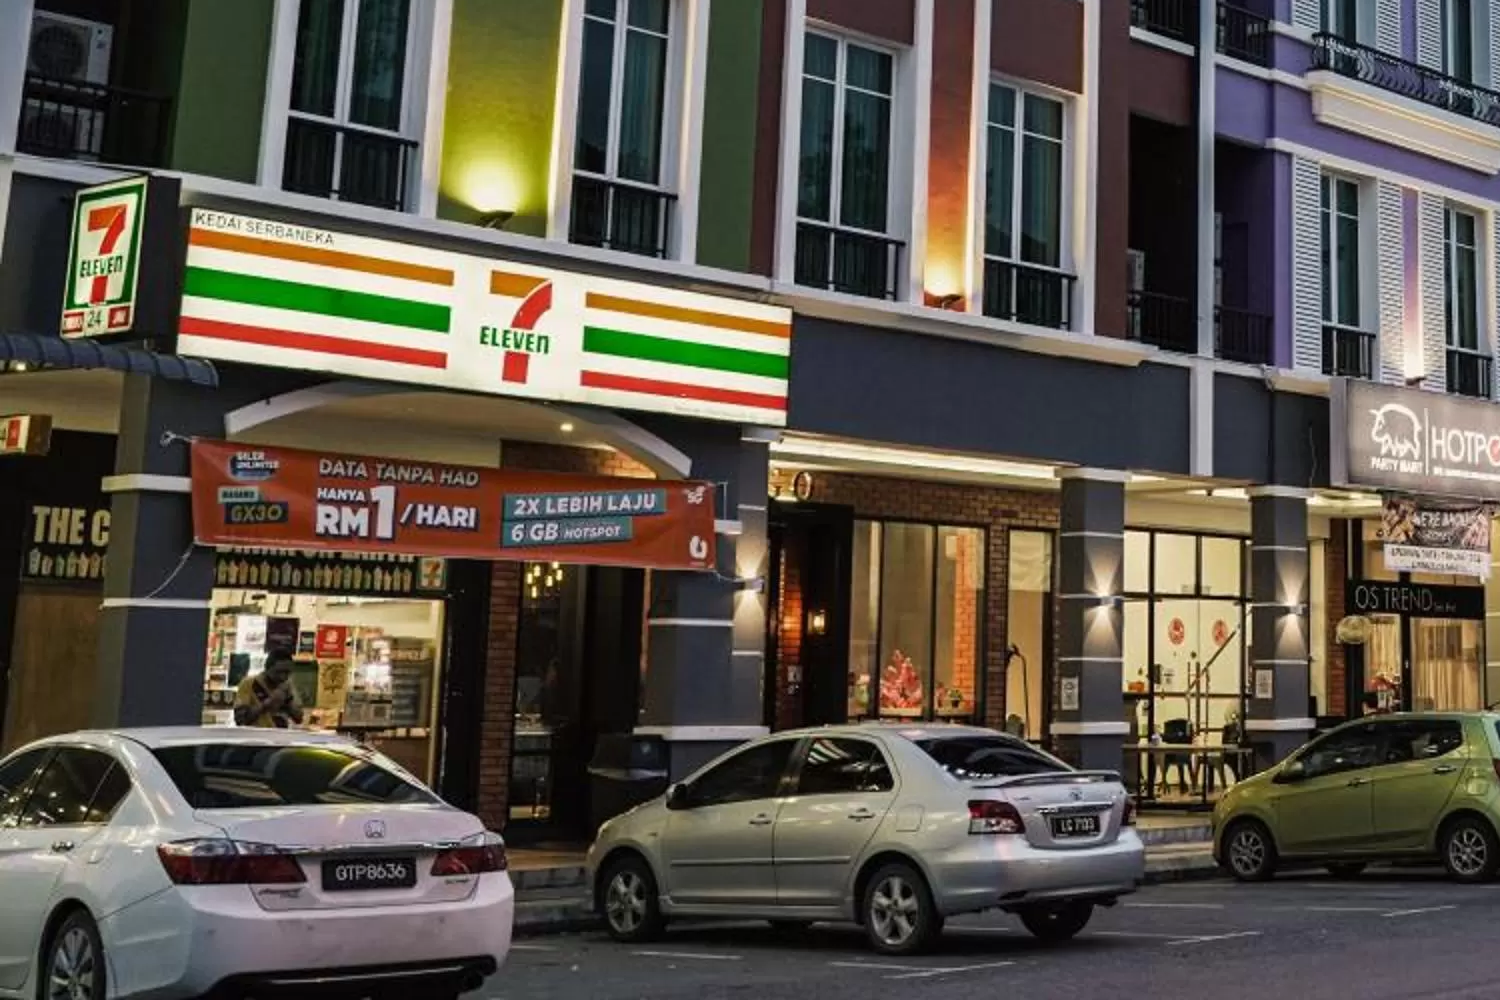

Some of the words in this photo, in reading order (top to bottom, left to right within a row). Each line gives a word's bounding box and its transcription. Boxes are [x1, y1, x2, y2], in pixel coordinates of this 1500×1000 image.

[195, 213, 241, 231] KEDAI
[245, 220, 335, 245] SERBANEKA
[87, 203, 128, 305] 7
[87, 309, 102, 328] 24
[489, 269, 553, 385] 7
[318, 458, 369, 478] DATA
[375, 462, 435, 484] TANPA
[439, 467, 480, 487] HAD
[1370, 456, 1398, 472] PARTY
[316, 486, 366, 502] HANYA
[513, 499, 540, 516] 2X
[545, 496, 603, 514] LEBIH
[607, 492, 656, 512] LAJU
[32, 505, 87, 545] THE
[231, 503, 283, 522] GX30
[511, 524, 524, 542] 6
[530, 522, 559, 541] GB
[563, 525, 621, 539] HOTSPOT
[1355, 585, 1379, 610] OS
[1383, 586, 1434, 612] TREND
